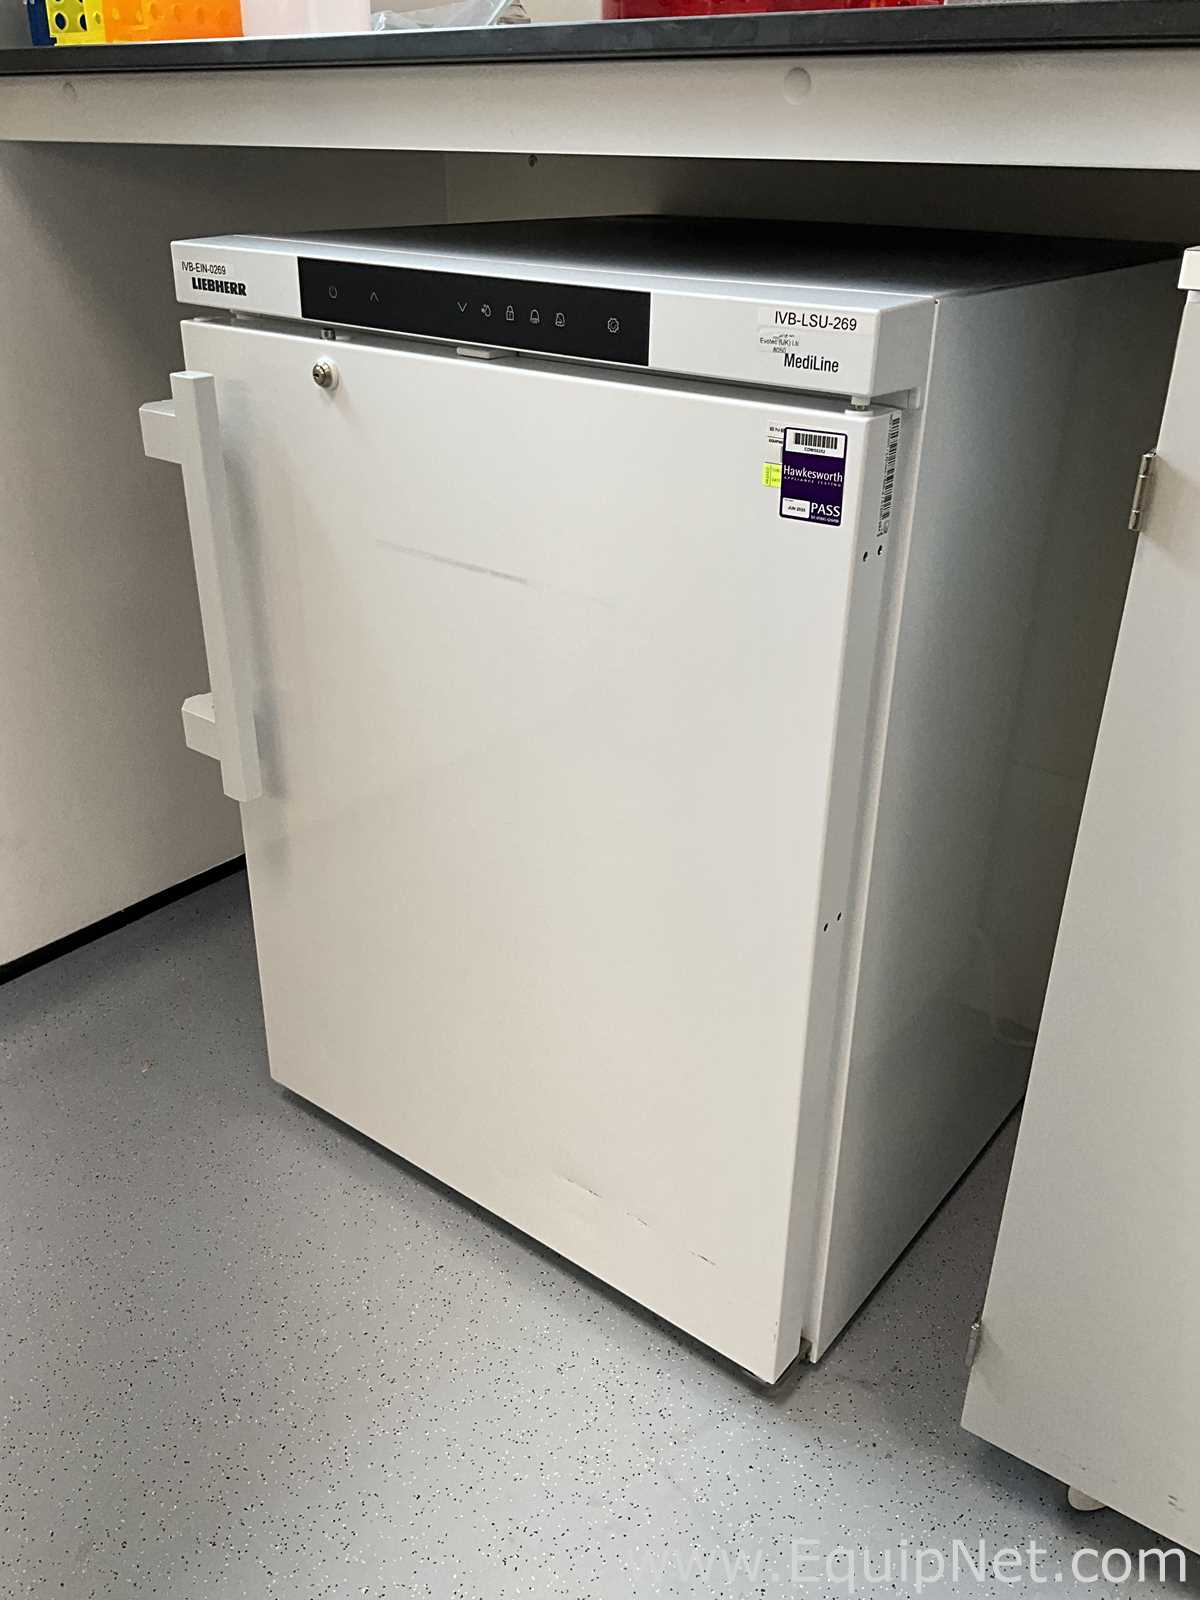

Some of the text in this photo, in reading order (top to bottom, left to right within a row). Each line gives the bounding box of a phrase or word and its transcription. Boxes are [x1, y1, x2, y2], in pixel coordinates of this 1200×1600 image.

[181, 261, 226, 275] IVB-EIN-0269
[191, 277, 247, 296] LIEBHERR
[774, 310, 857, 331] IVB-LSU-269
[783, 353, 839, 373] MediLine
[783, 464, 843, 483] Hawkesworth
[811, 502, 840, 517] PASS
